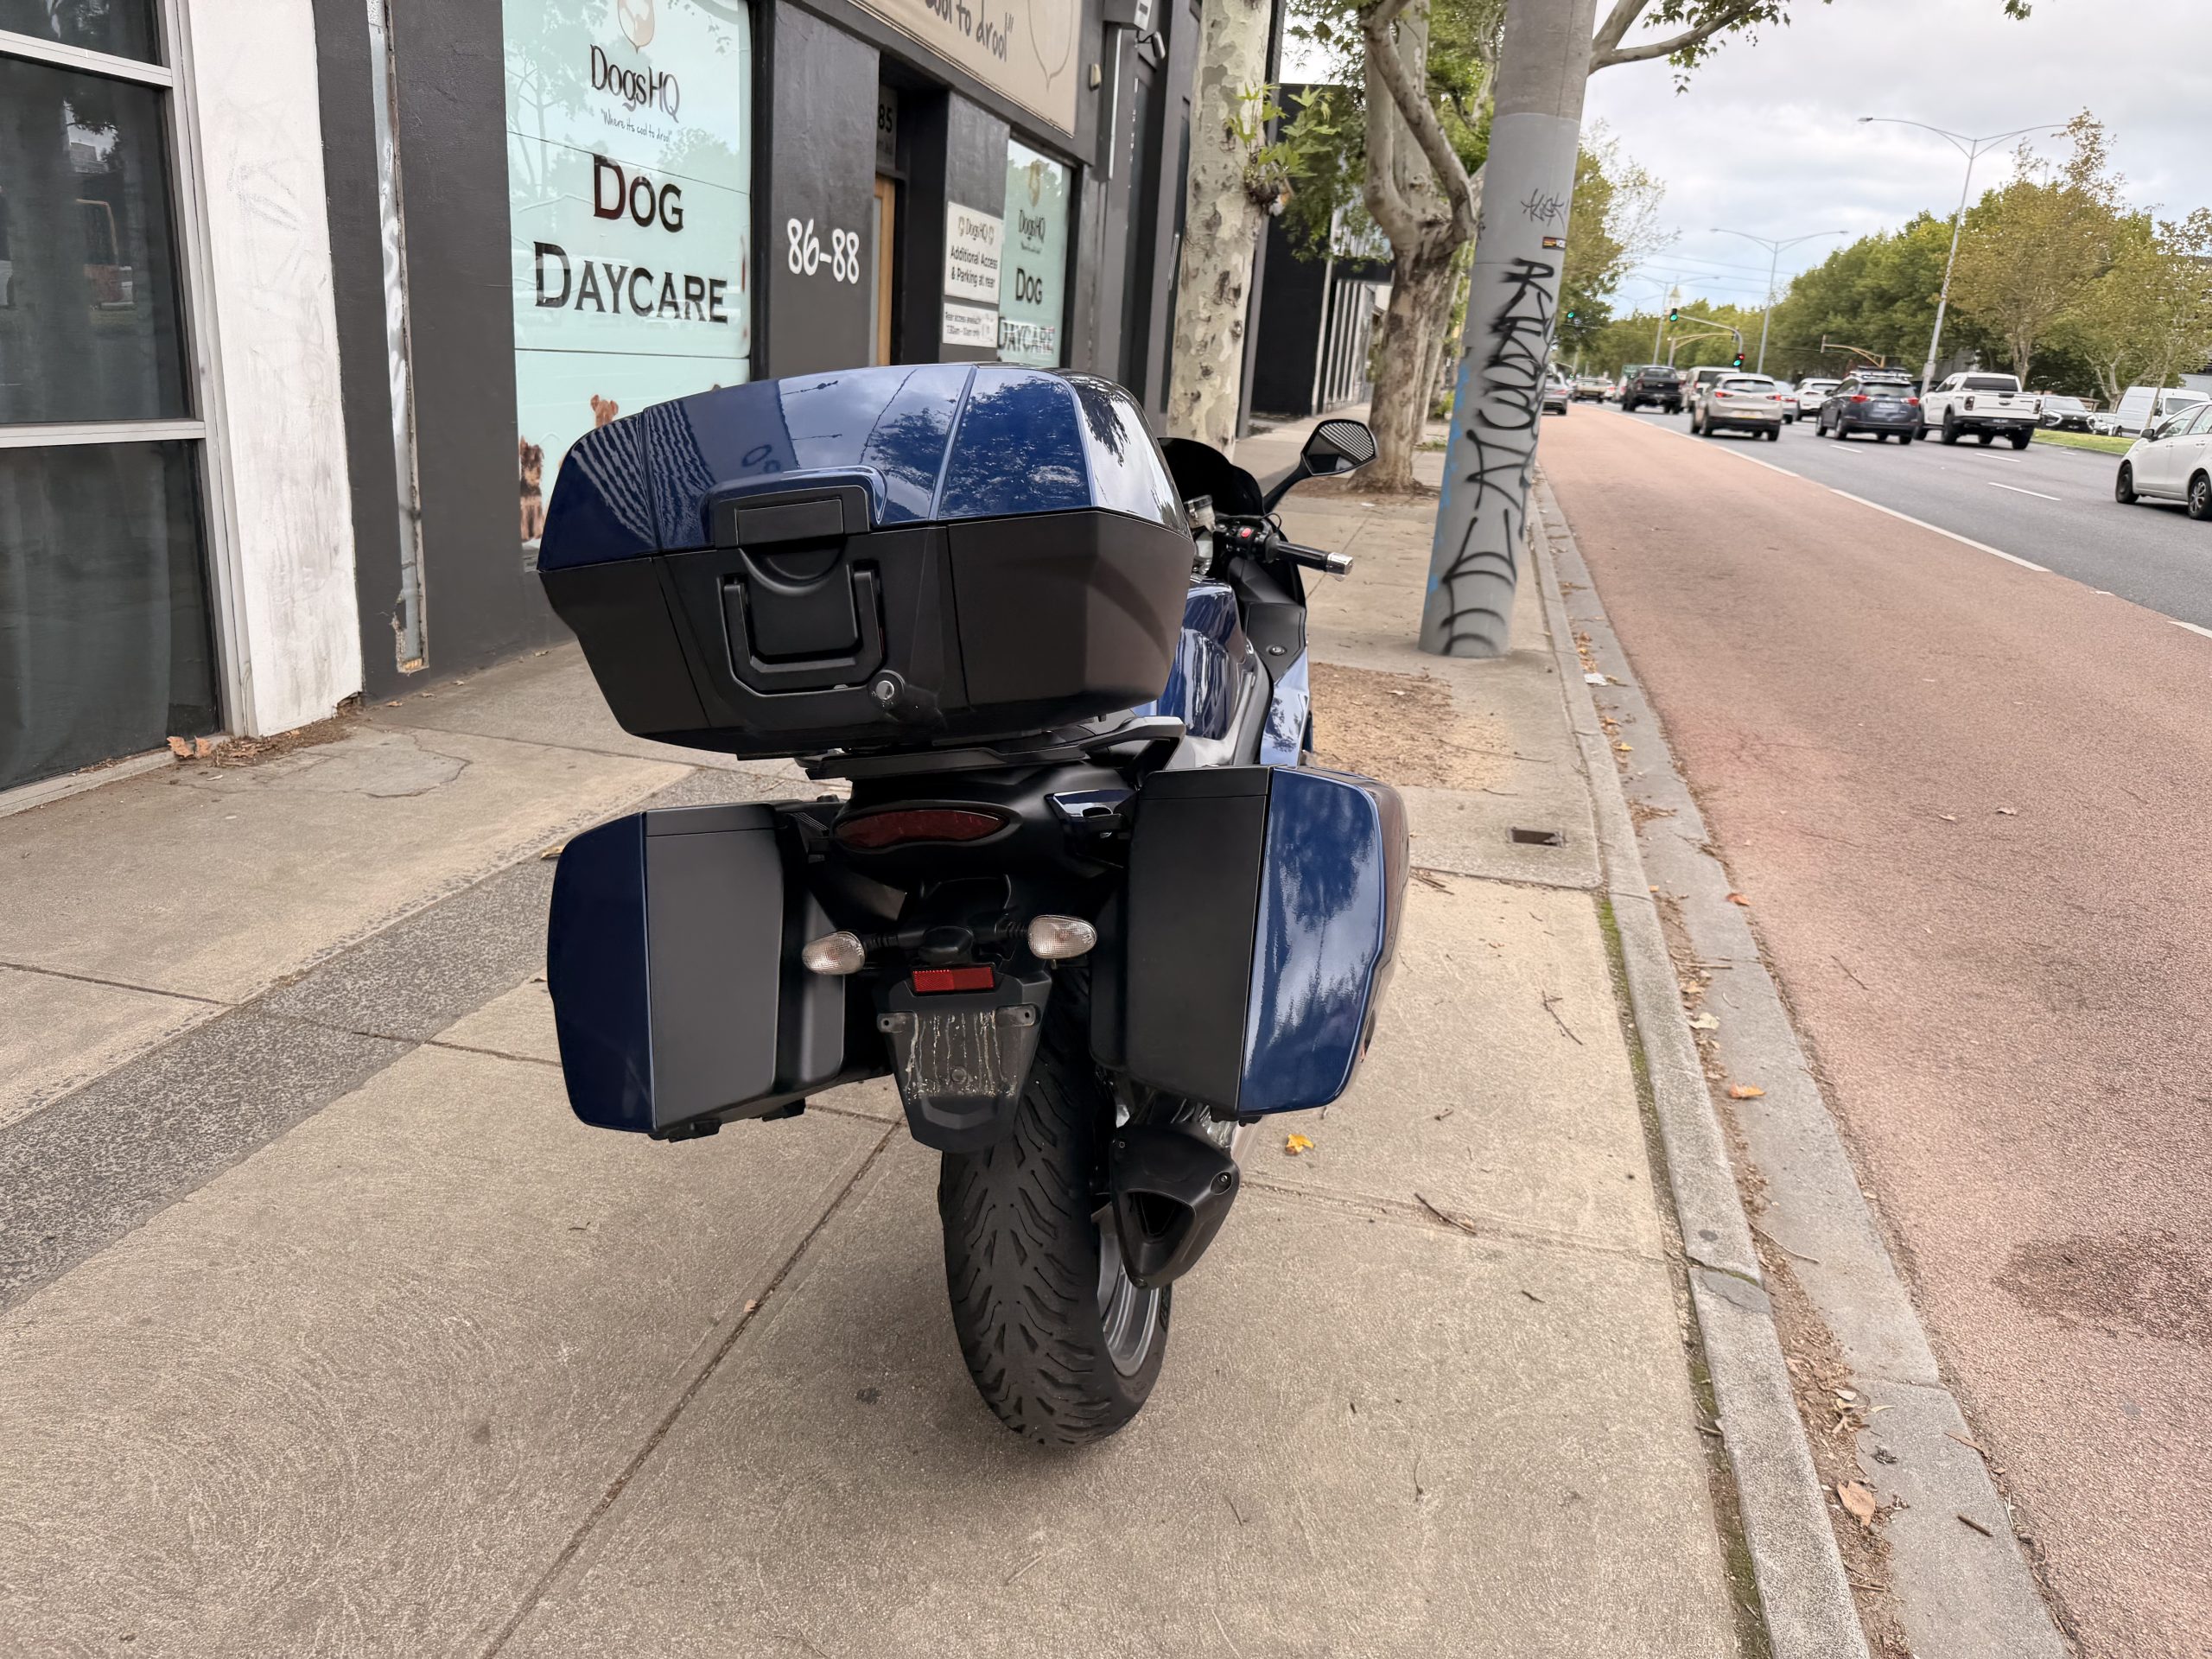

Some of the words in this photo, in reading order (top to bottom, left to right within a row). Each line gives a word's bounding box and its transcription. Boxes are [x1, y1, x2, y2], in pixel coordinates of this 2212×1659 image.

[925, 0, 952, 24] ool
[956, 0, 972, 37] to
[590, 44, 680, 124] DogsHQ
[648, 124, 655, 139] to
[593, 153, 684, 233] DOG
[787, 218, 860, 284] 86-88
[950, 245, 980, 265] Additional
[980, 253, 999, 270] Access
[533, 241, 728, 325] DAYCARE
[957, 267, 978, 288] Parking
[1015, 267, 1044, 305] DOG
